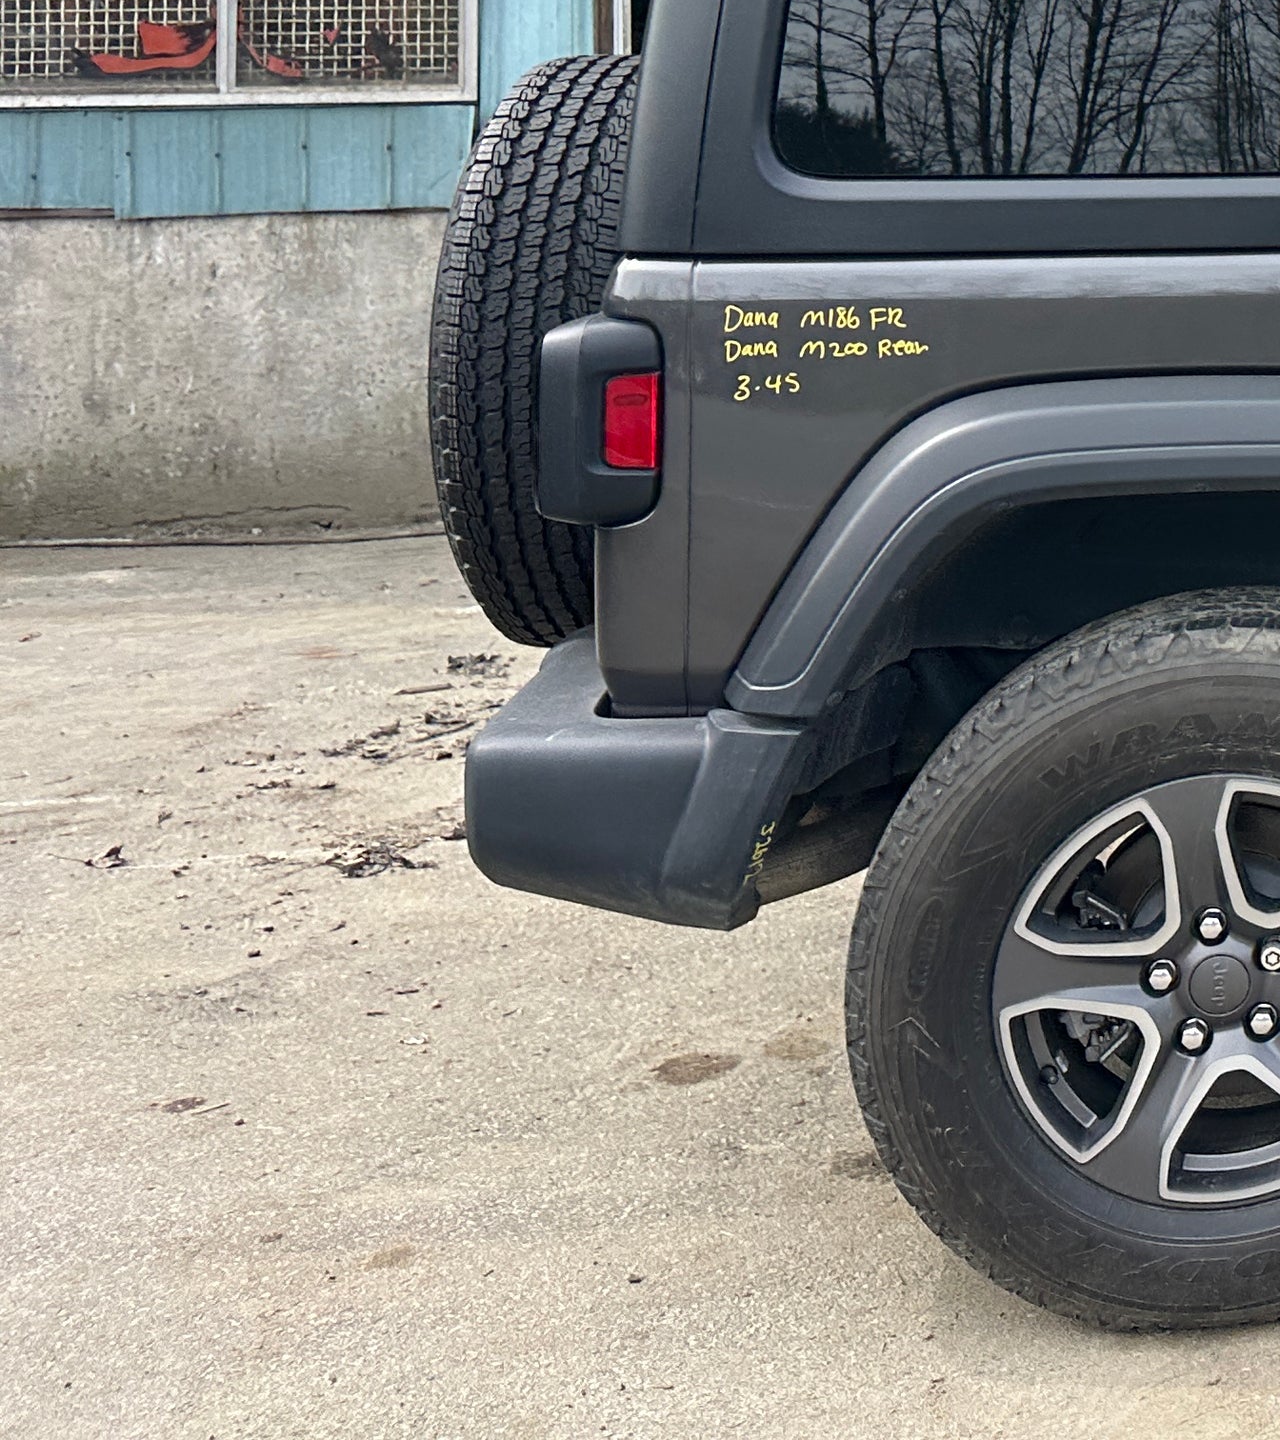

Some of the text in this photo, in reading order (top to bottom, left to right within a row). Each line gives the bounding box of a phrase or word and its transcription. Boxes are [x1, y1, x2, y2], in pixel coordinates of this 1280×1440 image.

[724, 304, 780, 333] Dana
[868, 307, 908, 331] FR
[724, 339, 778, 363] Dana
[878, 338, 930, 359] Rear
[733, 371, 801, 401] 3.45
